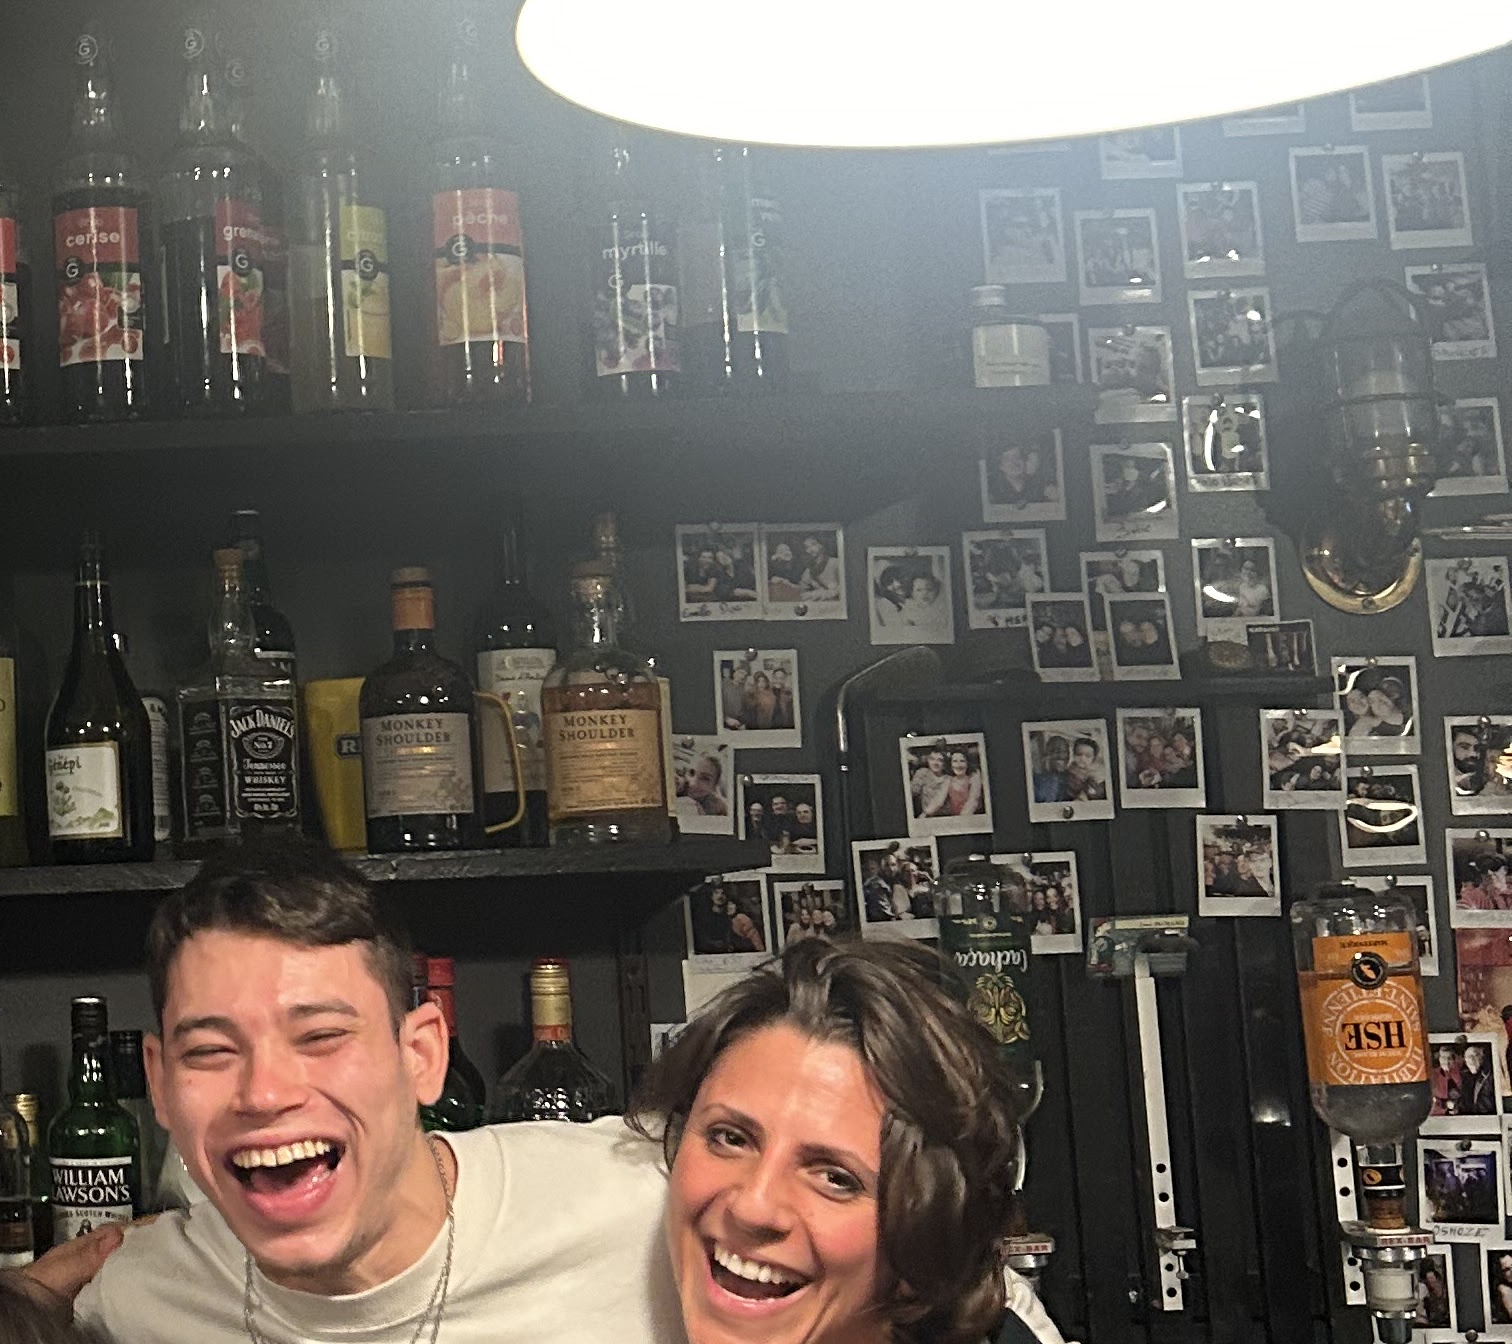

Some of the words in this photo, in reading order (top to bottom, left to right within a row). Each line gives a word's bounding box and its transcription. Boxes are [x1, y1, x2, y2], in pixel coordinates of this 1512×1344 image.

[64, 229, 121, 248] cerise
[229, 715, 256, 739] JACK
[380, 717, 444, 732] MONKEY
[563, 714, 628, 727] MONKEY
[375, 731, 451, 746] SHOULDER
[559, 728, 636, 741] SHOULDER
[244, 775, 286, 784] WHISKEY
[1341, 1019, 1407, 1052] HSE
[51, 1167, 124, 1187] WILLIAM
